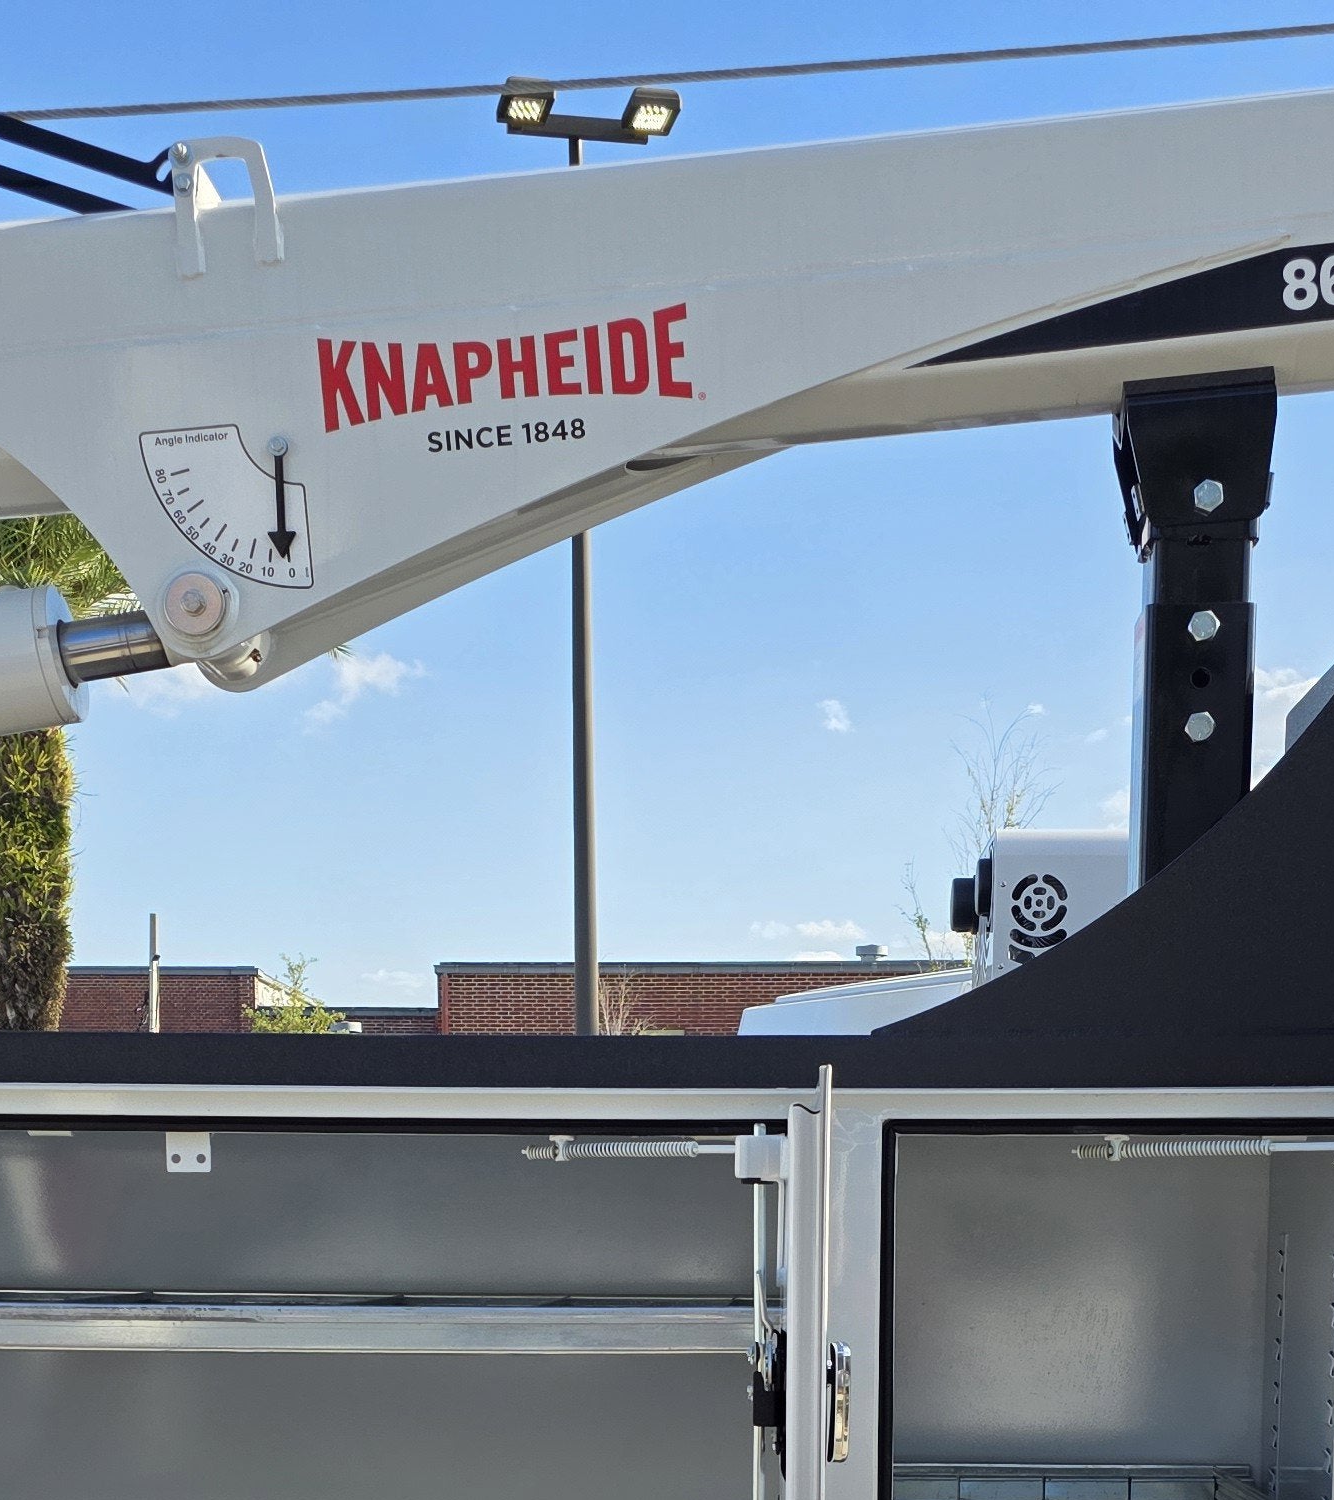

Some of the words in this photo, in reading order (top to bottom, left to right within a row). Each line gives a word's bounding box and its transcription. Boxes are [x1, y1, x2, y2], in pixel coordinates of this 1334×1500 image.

[317, 302, 693, 433] KNAPHEIDE
[154, 436, 183, 447] Angle
[185, 432, 229, 444] Indicator
[427, 424, 513, 453] SINCE
[521, 418, 586, 445] 1848
[154, 468, 167, 484] 80
[162, 489, 175, 506] 70
[173, 509, 187, 525] 60
[185, 525, 200, 541] 50
[202, 541, 217, 556] 40
[219, 553, 235, 567] 30
[238, 561, 253, 574] 20
[261, 566, 275, 578] 10
[288, 567, 296, 578] 0
